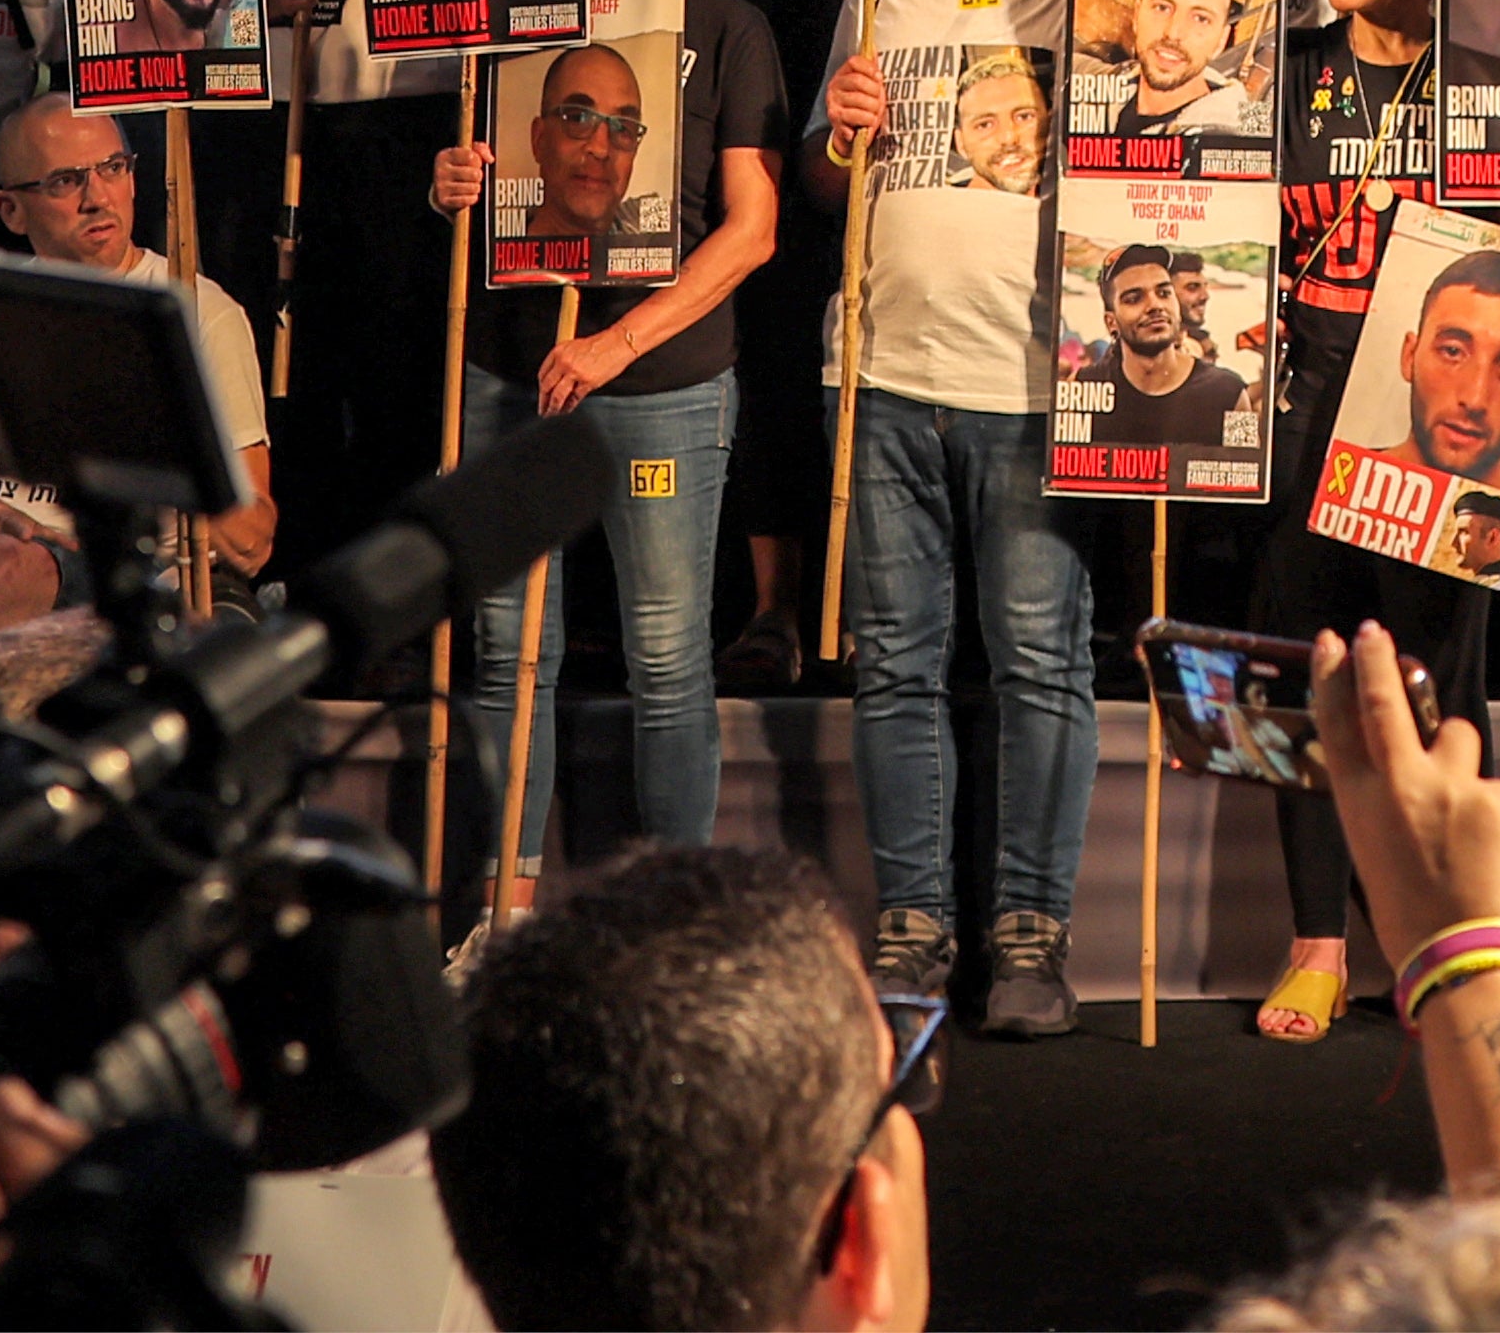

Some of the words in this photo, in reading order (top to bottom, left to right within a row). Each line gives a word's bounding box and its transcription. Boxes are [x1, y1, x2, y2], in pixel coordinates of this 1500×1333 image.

[78, 23, 116, 55] HIM
[373, 5, 432, 39] HOME
[78, 57, 133, 93] HOME
[139, 53, 187, 88] NOW!
[1069, 74, 1129, 104] BRING
[886, 101, 950, 132] TAKEN
[1069, 104, 1107, 133] HIM
[1067, 138, 1118, 170] HOME
[1121, 136, 1181, 169] NOW!
[886, 158, 943, 192] GAZA
[1131, 203, 1166, 221] YOSEF
[1168, 204, 1206, 222] OHANA
[1156, 222, 1179, 242] (24)
[1052, 446, 1104, 479] HOME
[1110, 445, 1168, 480] NOW!
[632, 463, 672, 497] 673
[1349, 456, 1436, 523] מתן
[1314, 500, 1421, 561] אנגרסט
